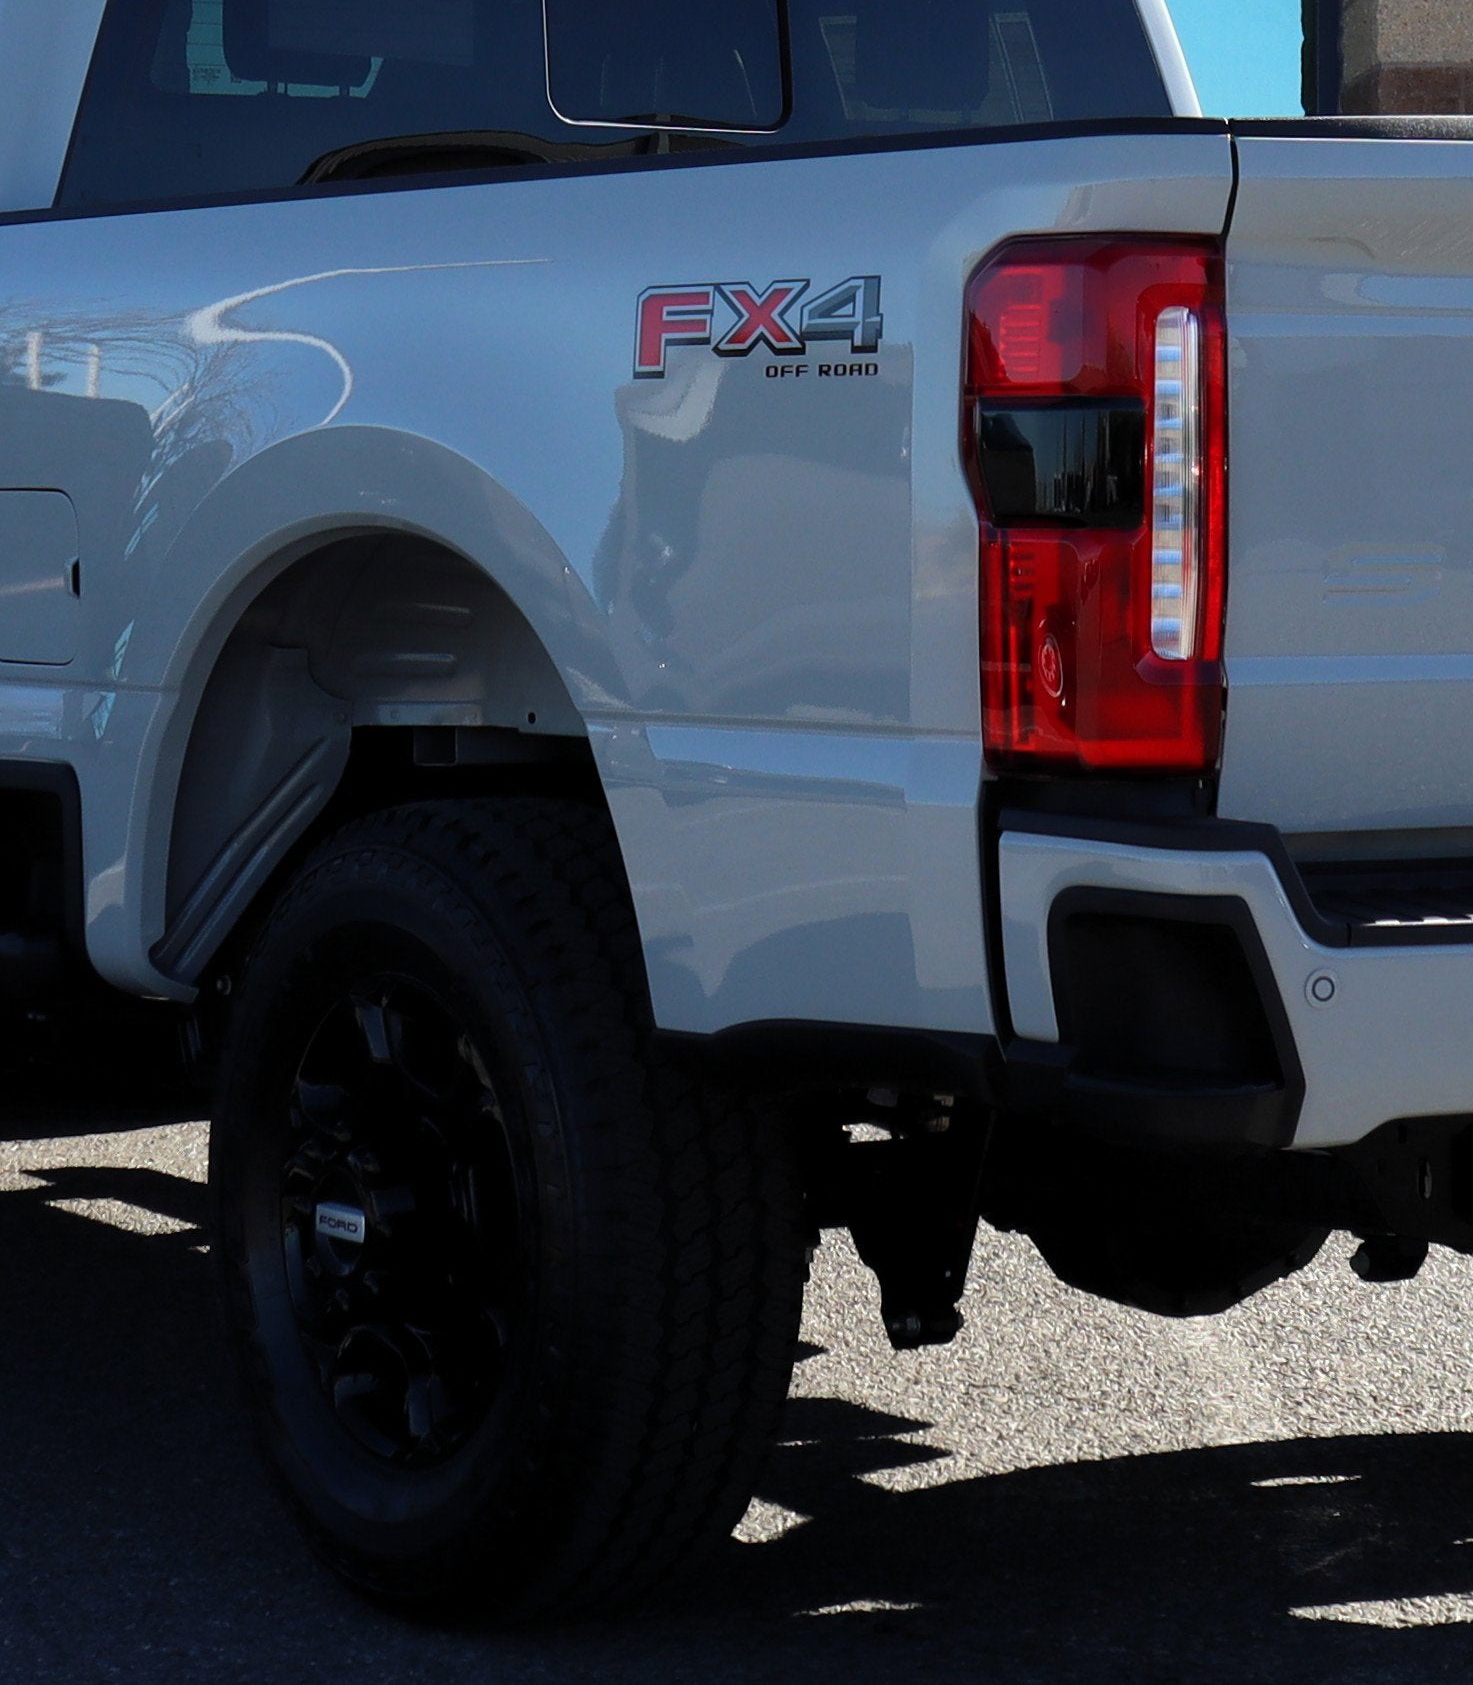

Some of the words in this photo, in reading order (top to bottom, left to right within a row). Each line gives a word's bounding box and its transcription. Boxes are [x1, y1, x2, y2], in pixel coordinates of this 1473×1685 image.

[632, 274, 883, 380] FX4
[765, 364, 809, 378] OFF
[818, 362, 879, 378] ROAD
[318, 1214, 358, 1233] FORD
